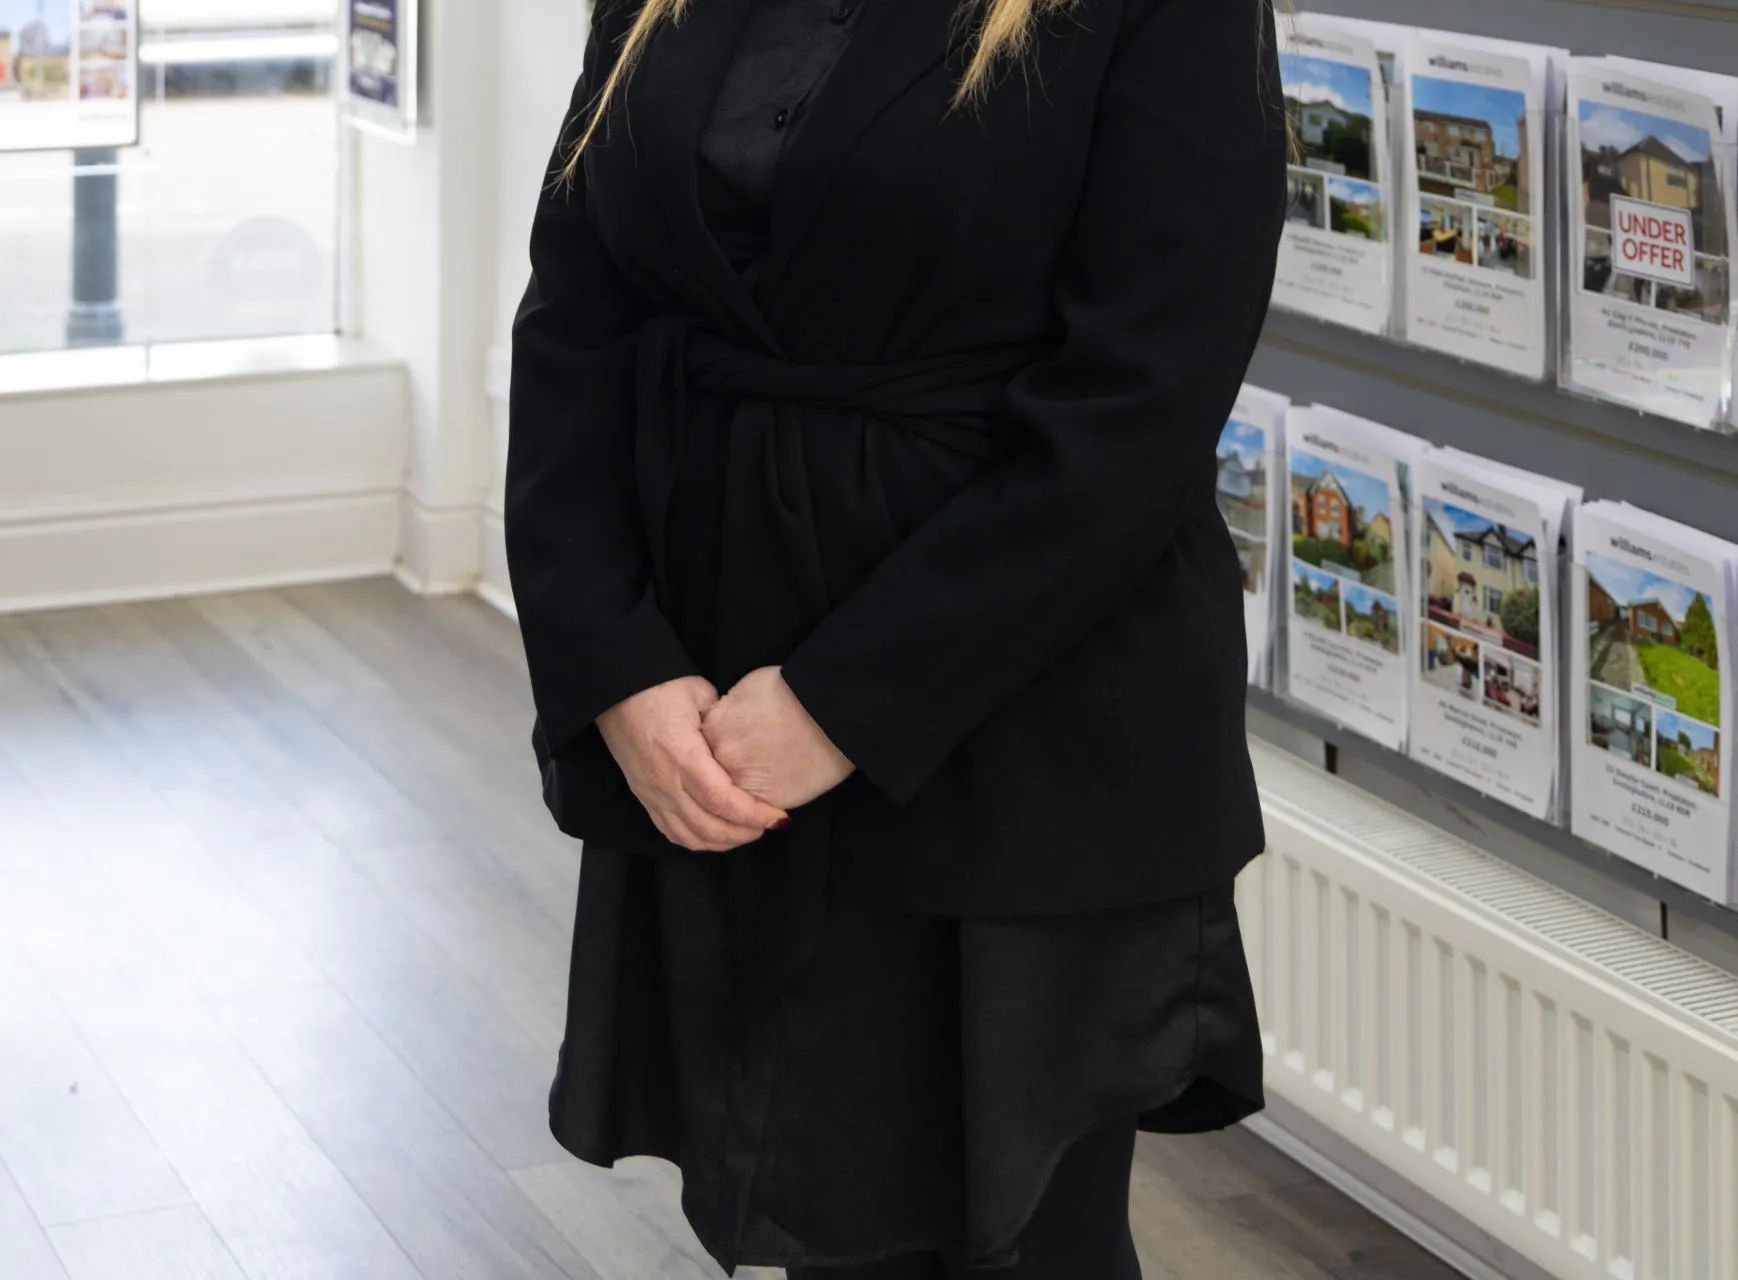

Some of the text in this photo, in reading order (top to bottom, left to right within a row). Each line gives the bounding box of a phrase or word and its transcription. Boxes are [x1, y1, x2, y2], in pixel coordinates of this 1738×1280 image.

[1428, 54, 1469, 72] williams
[1601, 79, 1648, 102] williams
[1618, 210, 1687, 246] UNDER
[1622, 237, 1684, 272] OFFER
[1609, 534, 1652, 562] williams
